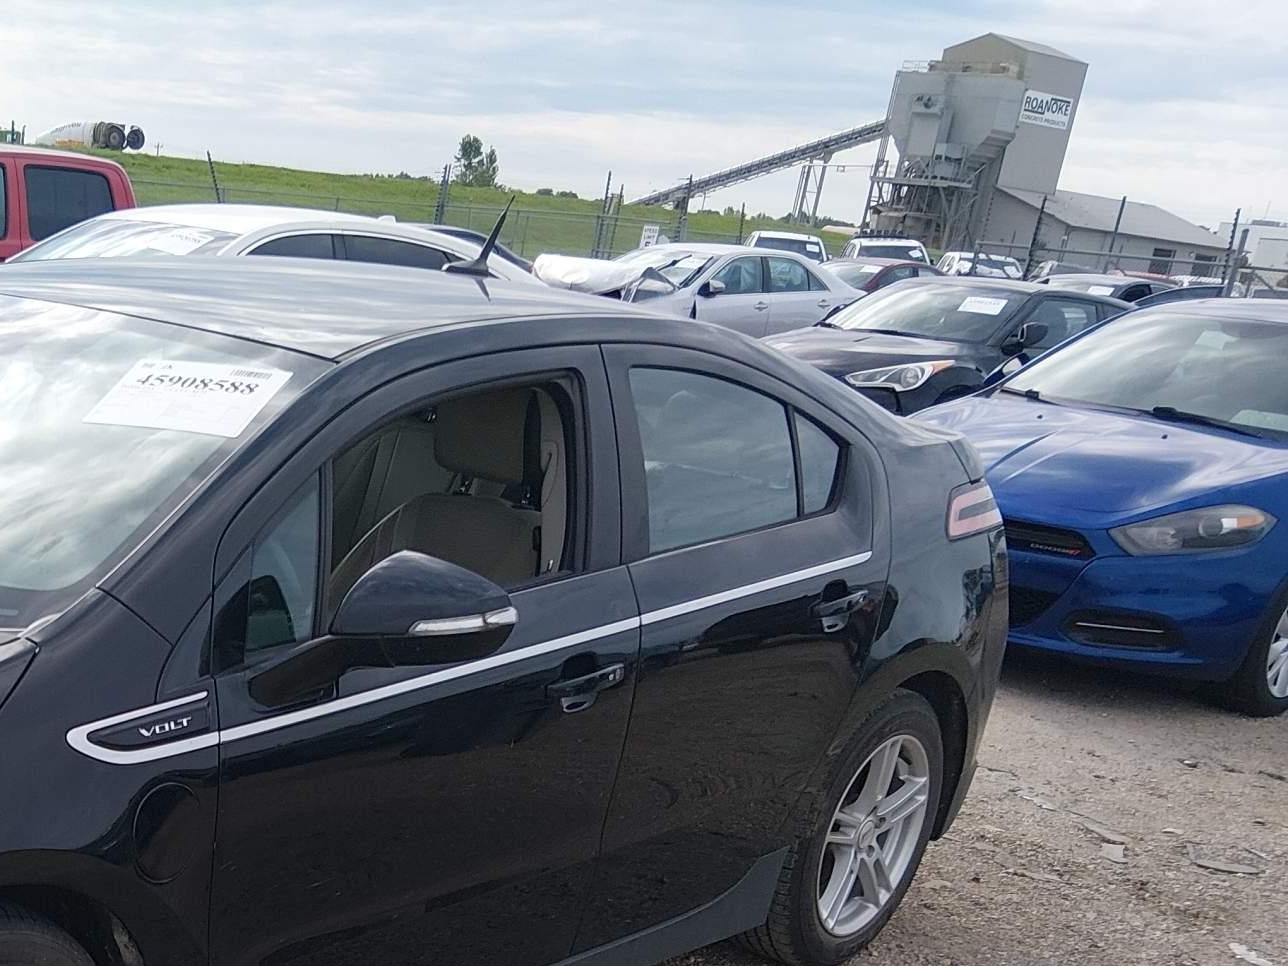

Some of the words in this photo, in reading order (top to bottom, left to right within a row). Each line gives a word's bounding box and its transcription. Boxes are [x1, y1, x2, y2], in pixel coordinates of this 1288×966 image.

[1024, 95, 1071, 116] ROANOKE
[136, 373, 260, 395] 45908588
[138, 716, 192, 737] VOLT
